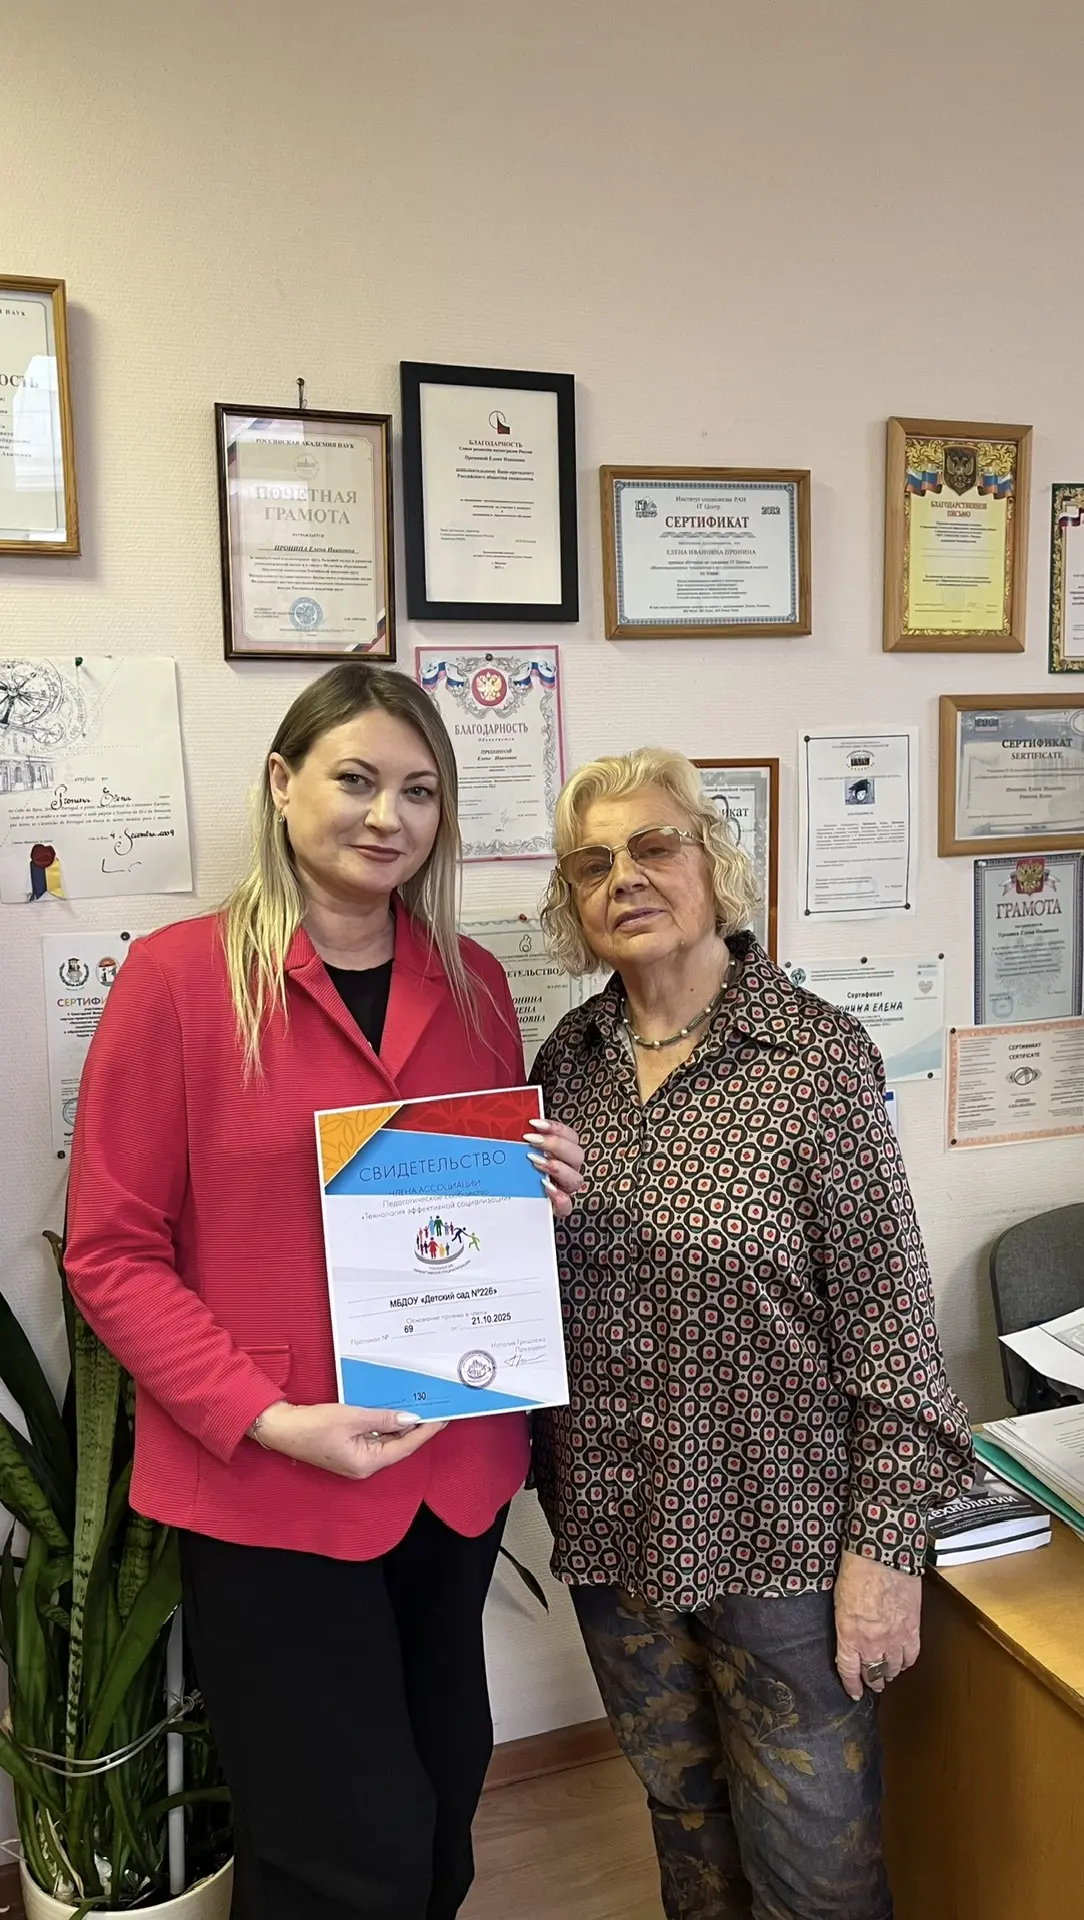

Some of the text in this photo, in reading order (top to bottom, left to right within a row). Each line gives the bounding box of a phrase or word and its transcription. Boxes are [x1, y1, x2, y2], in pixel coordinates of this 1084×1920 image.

[468, 440, 523, 448] БЛАГОДАРНОСТЬ
[255, 486, 357, 504] ПОЧЕТНАЯ
[264, 507, 351, 525] ГРАМОТА
[665, 516, 750, 529] СЕРТИФИКАТ
[454, 722, 529, 736] БЛАГОДАРНОСТЬ
[1001, 738, 1073, 749] СЕРТИФИКАТ
[1011, 752, 1063, 760] SERTIFICATE
[996, 898, 1062, 920] ГРАМОТА
[847, 991, 883, 999] Сертификат
[836, 1001, 904, 1013] ОНИНА ЕЛЕНА
[1008, 1043, 1041, 1051] СЕРТИФИКАТ
[1009, 1052, 1040, 1060] CERTIFICATE
[359, 1149, 506, 1182] СВИДЕТЕЛЬСТВО
[388, 1179, 481, 1196] ЧЛЕНА АССОЦИАЦИИ
[389, 1287, 498, 1308] МБДОУ «Детский сад №226»
[350, 1337, 381, 1347] Протокол
[403, 1324, 414, 1334] 69
[471, 1312, 512, 1325] 21.10.2025
[413, 1391, 427, 1401] 130
